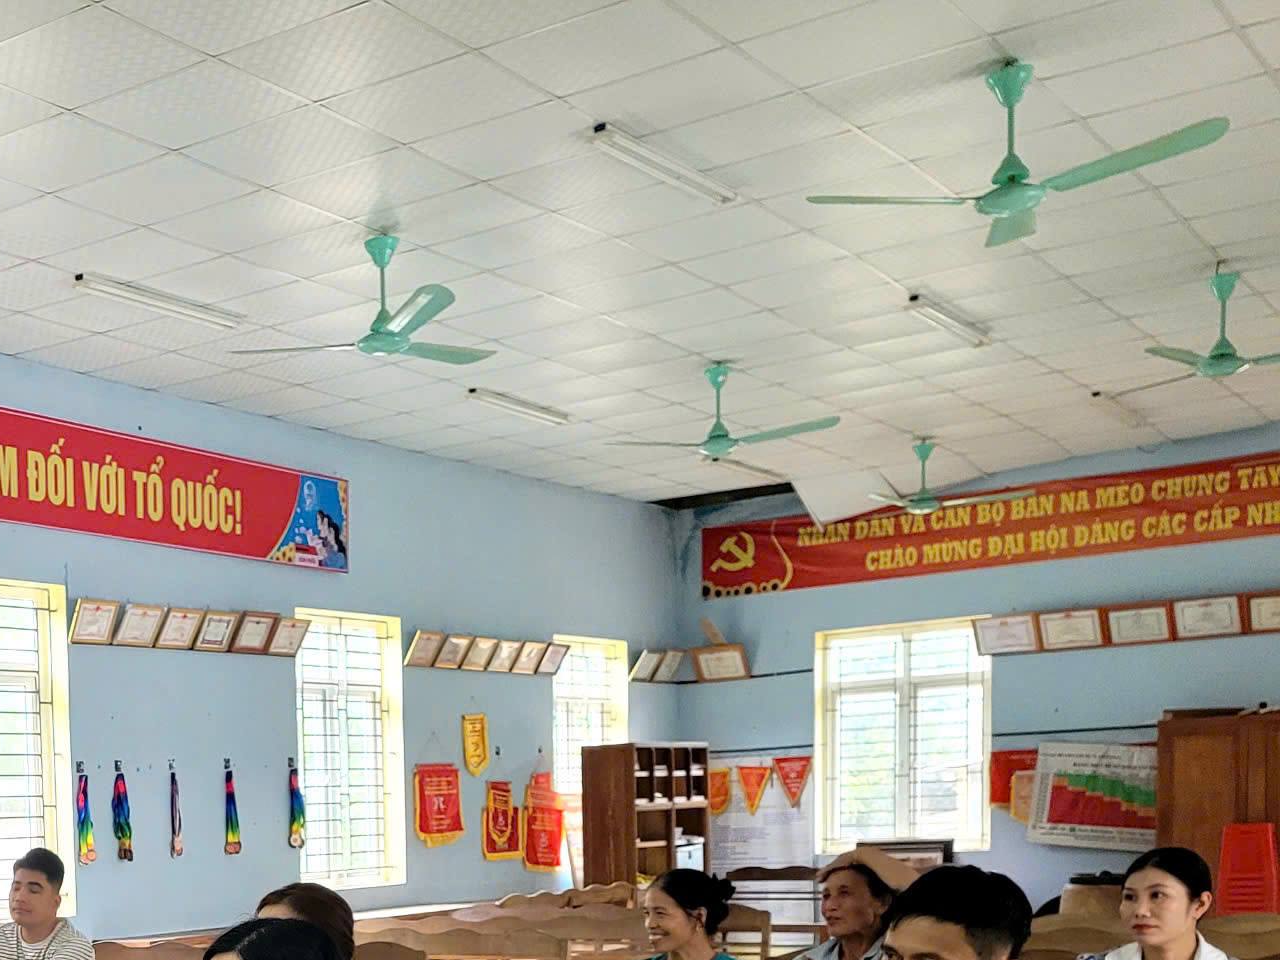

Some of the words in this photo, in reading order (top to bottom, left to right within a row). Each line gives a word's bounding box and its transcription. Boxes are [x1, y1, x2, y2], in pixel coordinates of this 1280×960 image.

[26, 437, 76, 508] ĐỐI
[81, 454, 126, 517] VỚI
[132, 455, 165, 522] TỔ
[170, 468, 243, 536] QUỐC!
[1059, 489, 1091, 514] NA
[1151, 470, 1231, 503] CHUNG
[865, 543, 919, 572] CHÀO
[922, 537, 983, 567] MỪNG
[988, 533, 1025, 560] ĐẠI
[1030, 524, 1069, 555] HỘI
[1074, 517, 1137, 547] ĐẢNG
[1141, 508, 1188, 539] CÁC
[1193, 498, 1241, 533] CẤP
